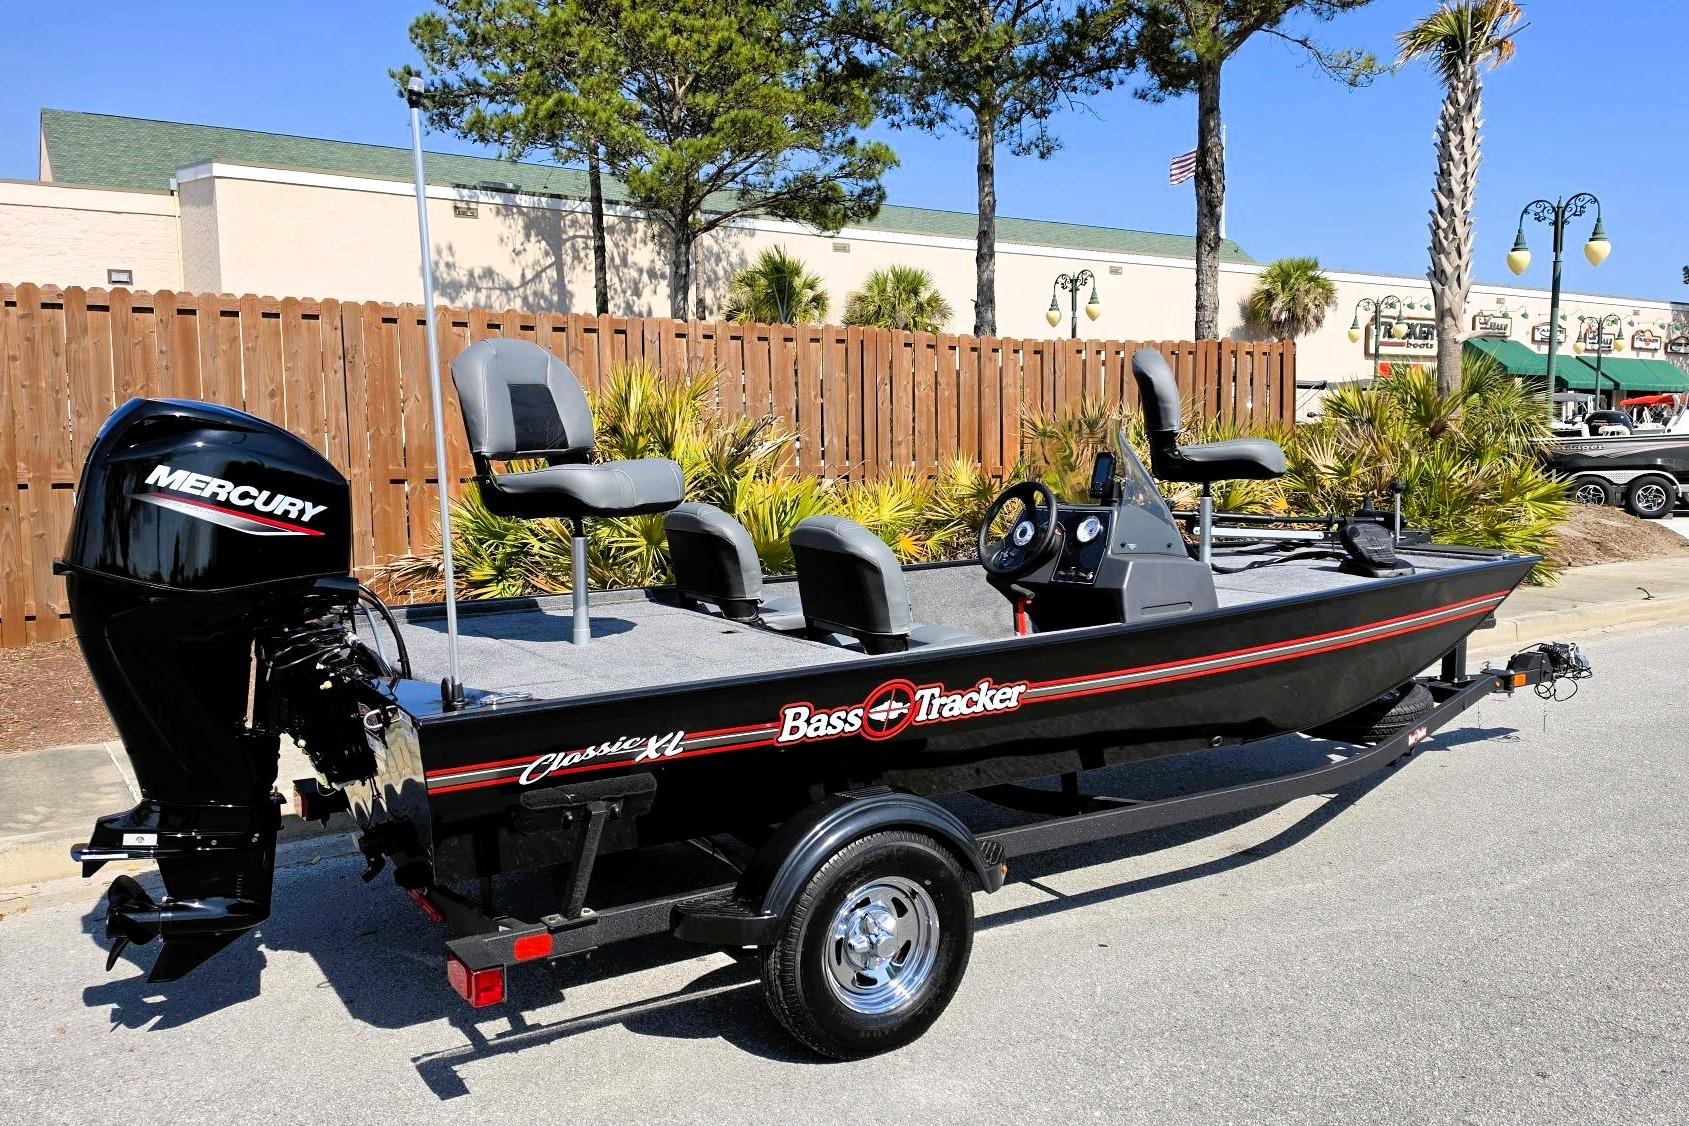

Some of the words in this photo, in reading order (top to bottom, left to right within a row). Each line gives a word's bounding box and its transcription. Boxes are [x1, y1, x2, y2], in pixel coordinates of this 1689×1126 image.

[1378, 321, 1436, 341] RKER
[145, 464, 328, 523] MERCURY
[778, 705, 862, 743] Bass
[914, 680, 1028, 724] Tracker
[518, 736, 646, 786] Classic
[635, 731, 687, 763] XL
